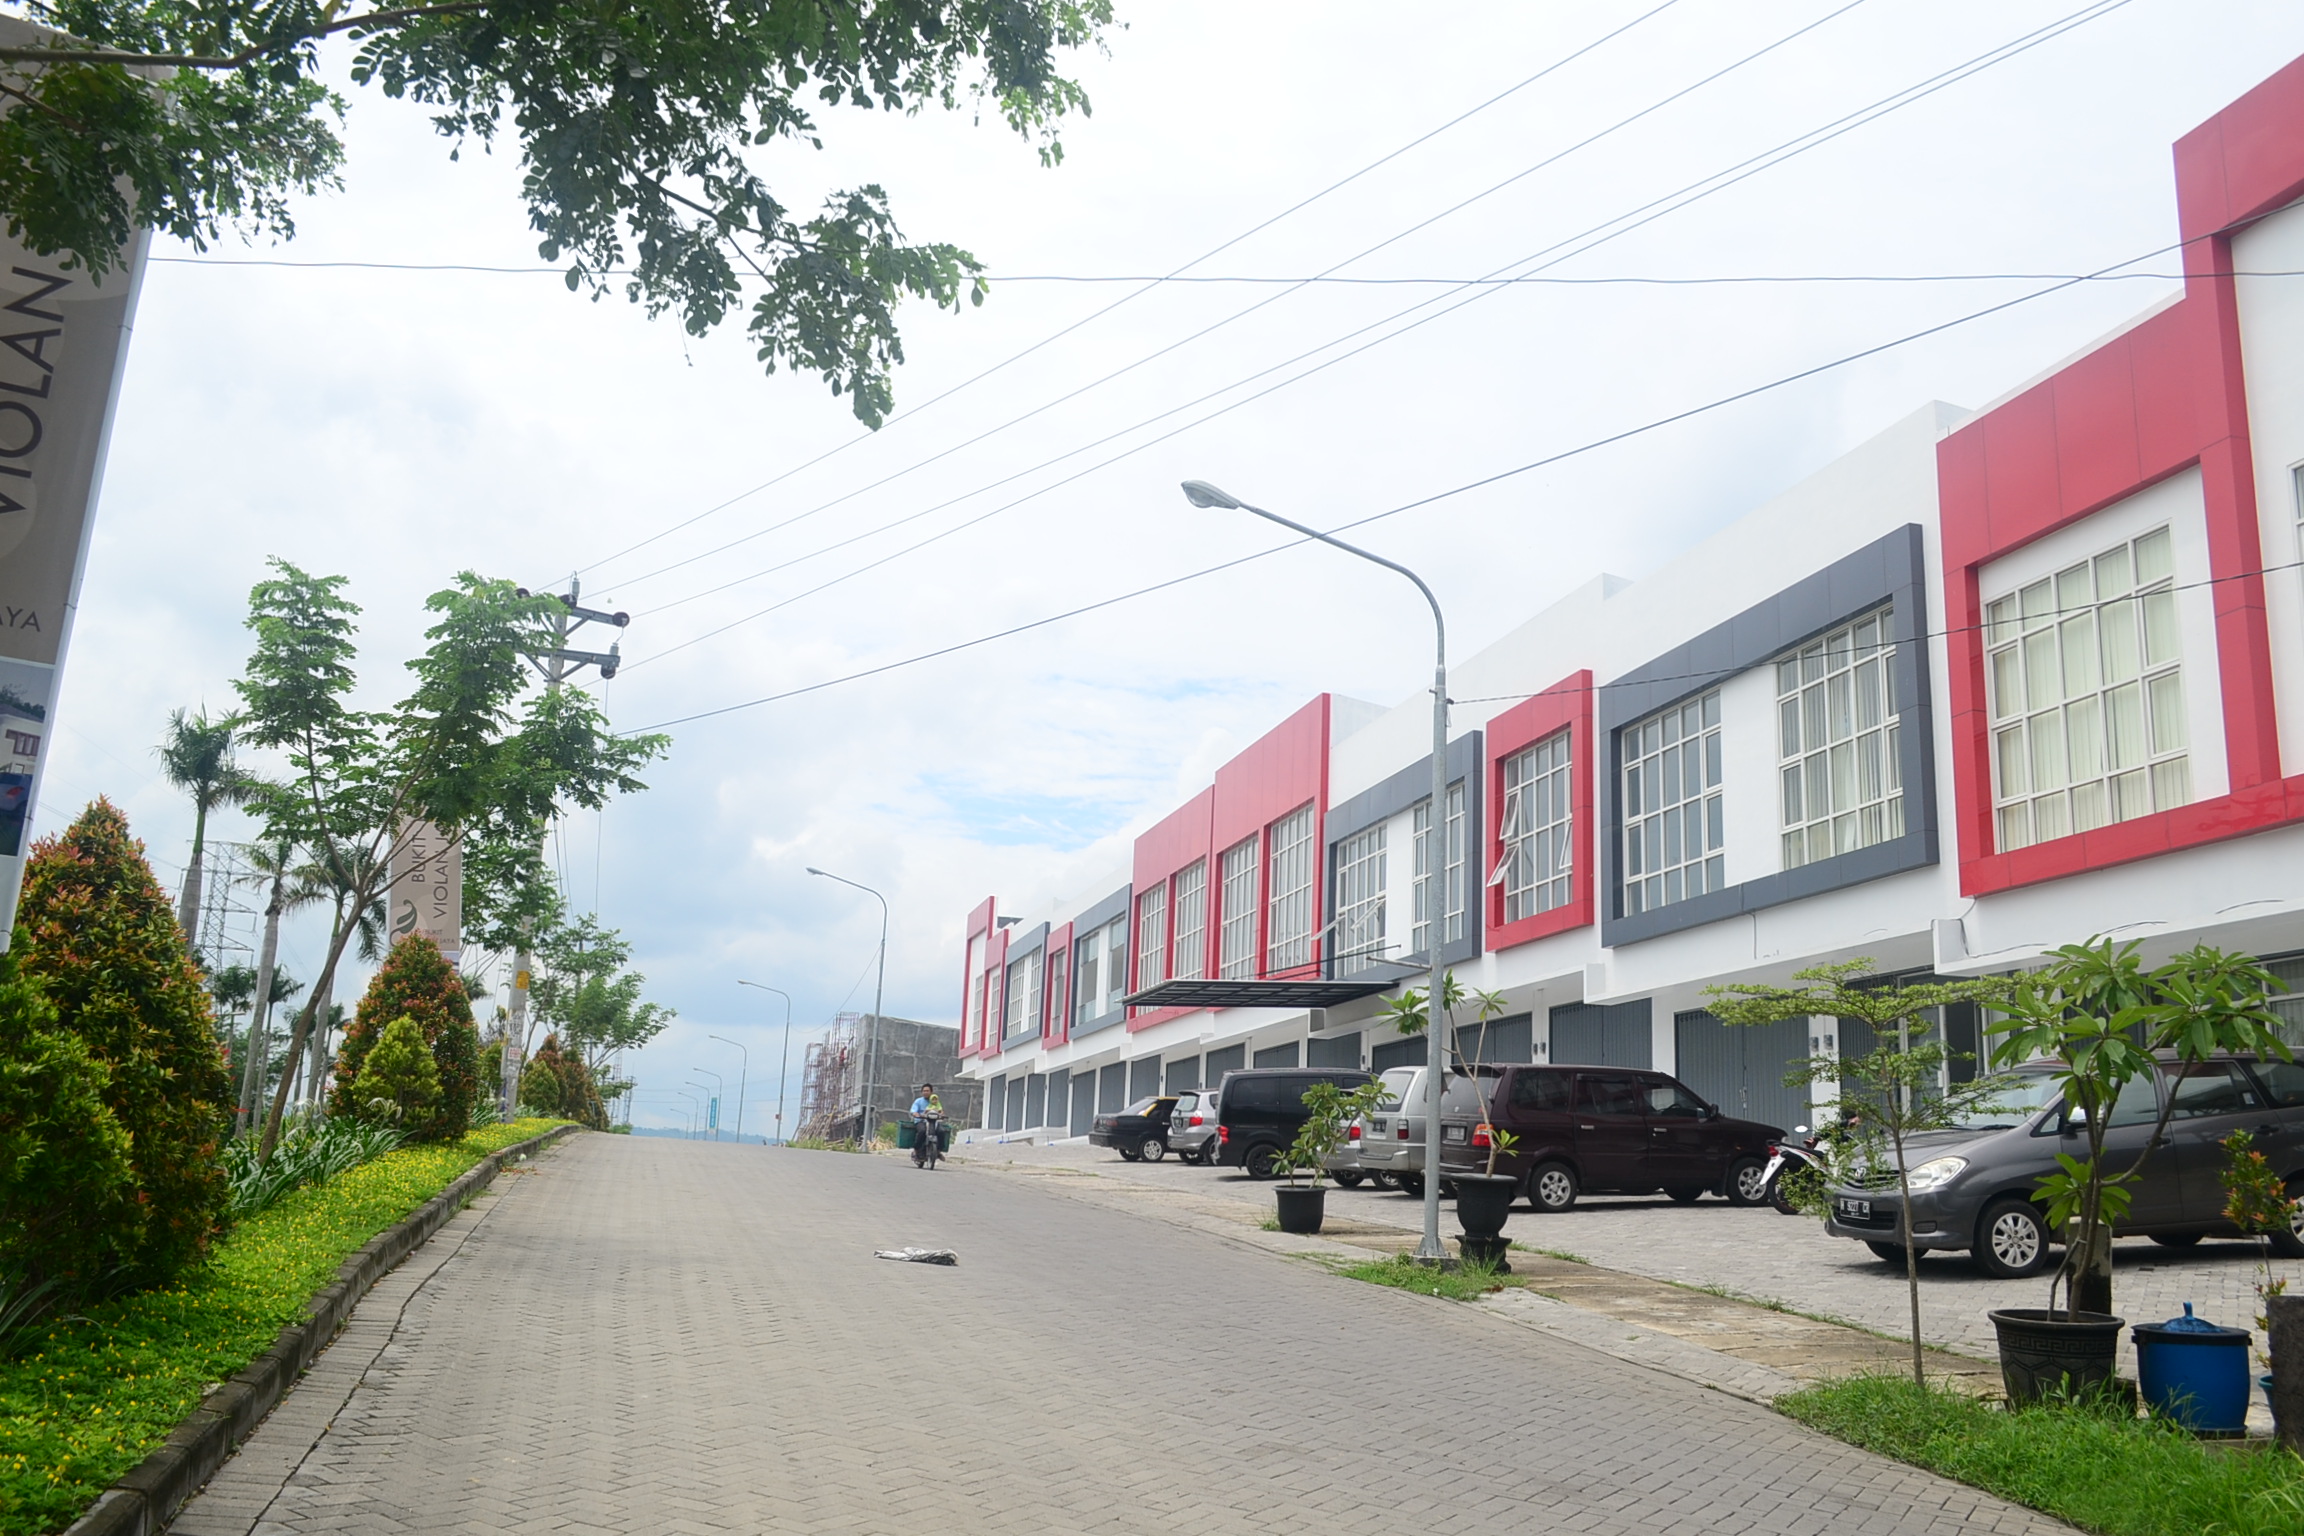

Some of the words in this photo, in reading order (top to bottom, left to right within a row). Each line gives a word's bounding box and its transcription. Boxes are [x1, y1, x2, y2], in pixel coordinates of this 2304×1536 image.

[0, 605, 41, 632] YA
[411, 834, 426, 883] BUKIT
[433, 850, 448, 919] VIOLAN
